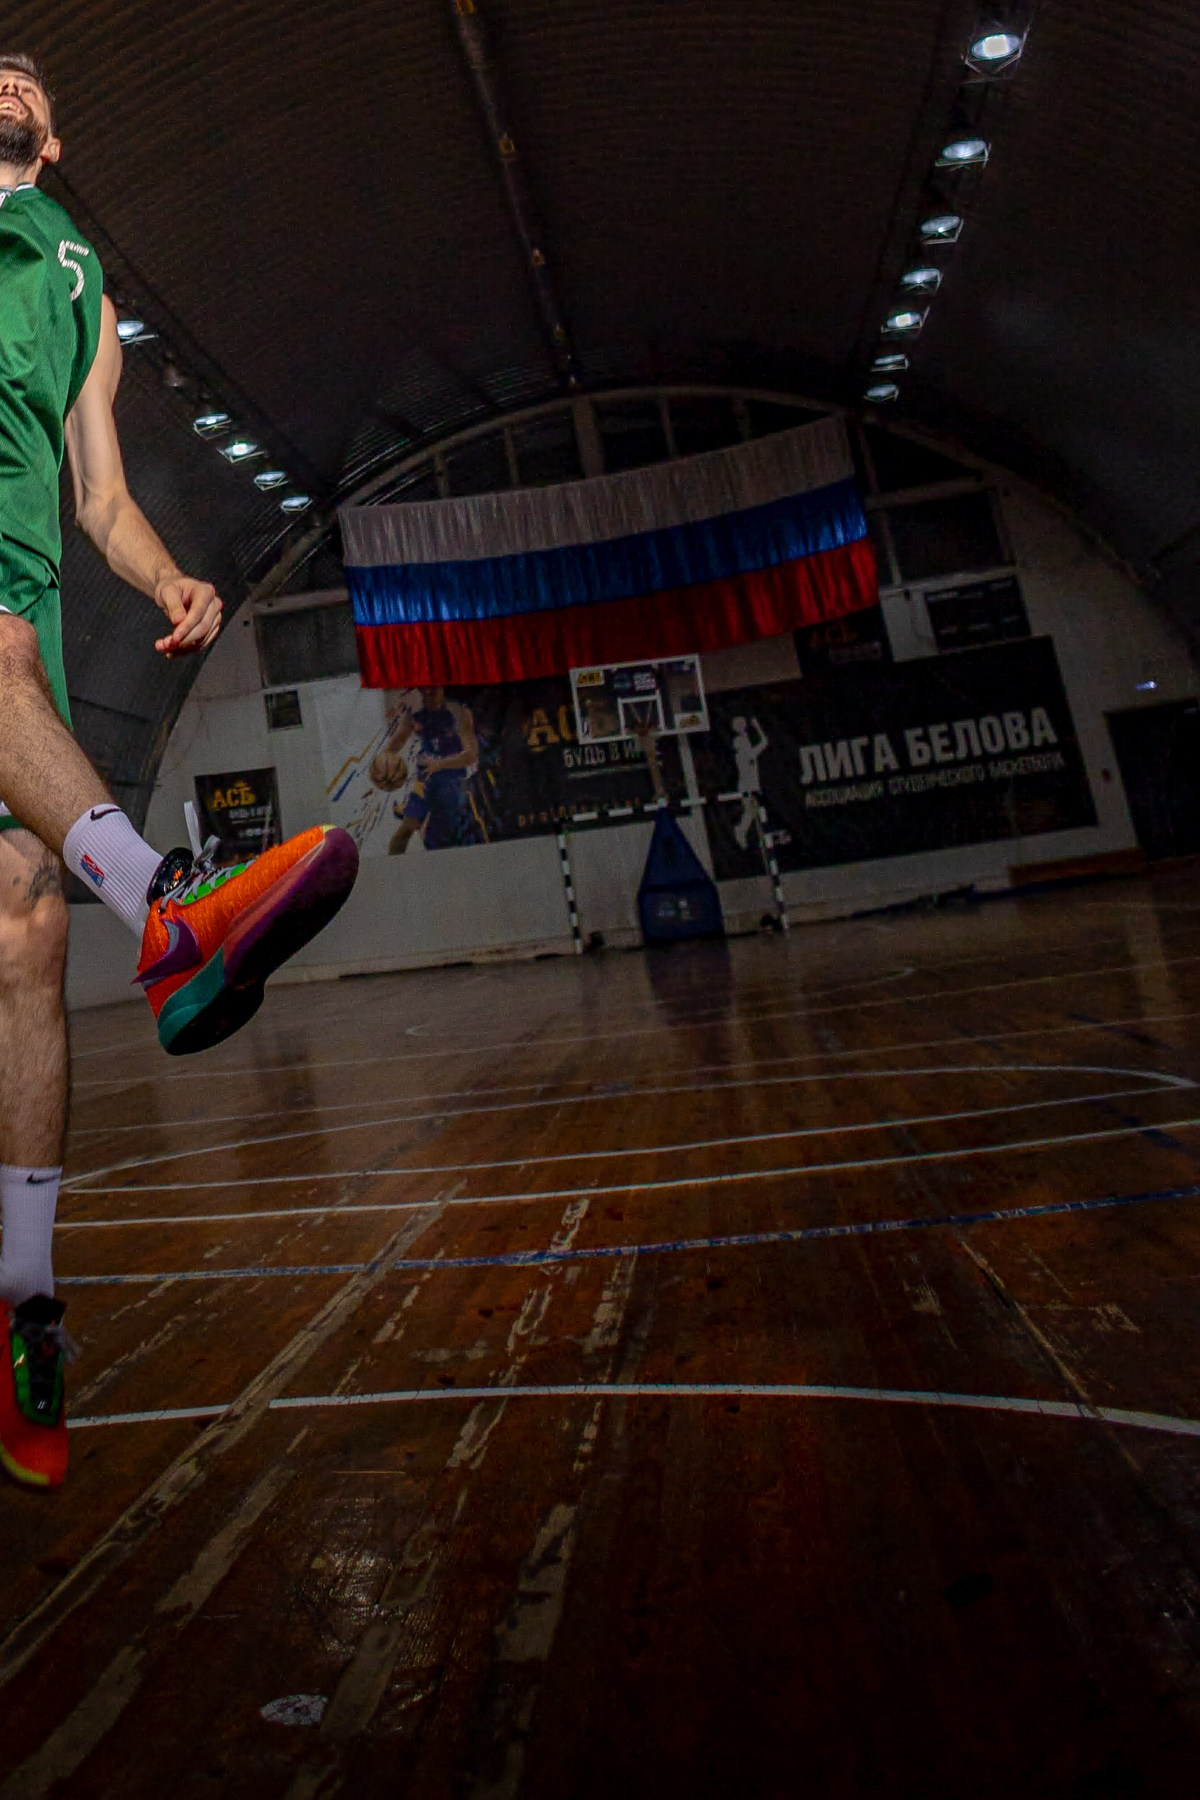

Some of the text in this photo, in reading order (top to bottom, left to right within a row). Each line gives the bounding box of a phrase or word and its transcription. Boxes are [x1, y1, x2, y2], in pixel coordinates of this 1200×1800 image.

[57, 239, 90, 302] 5
[799, 705, 1059, 787] ЛИГА БЕЛОВА
[208, 785, 257, 811] АСБ
